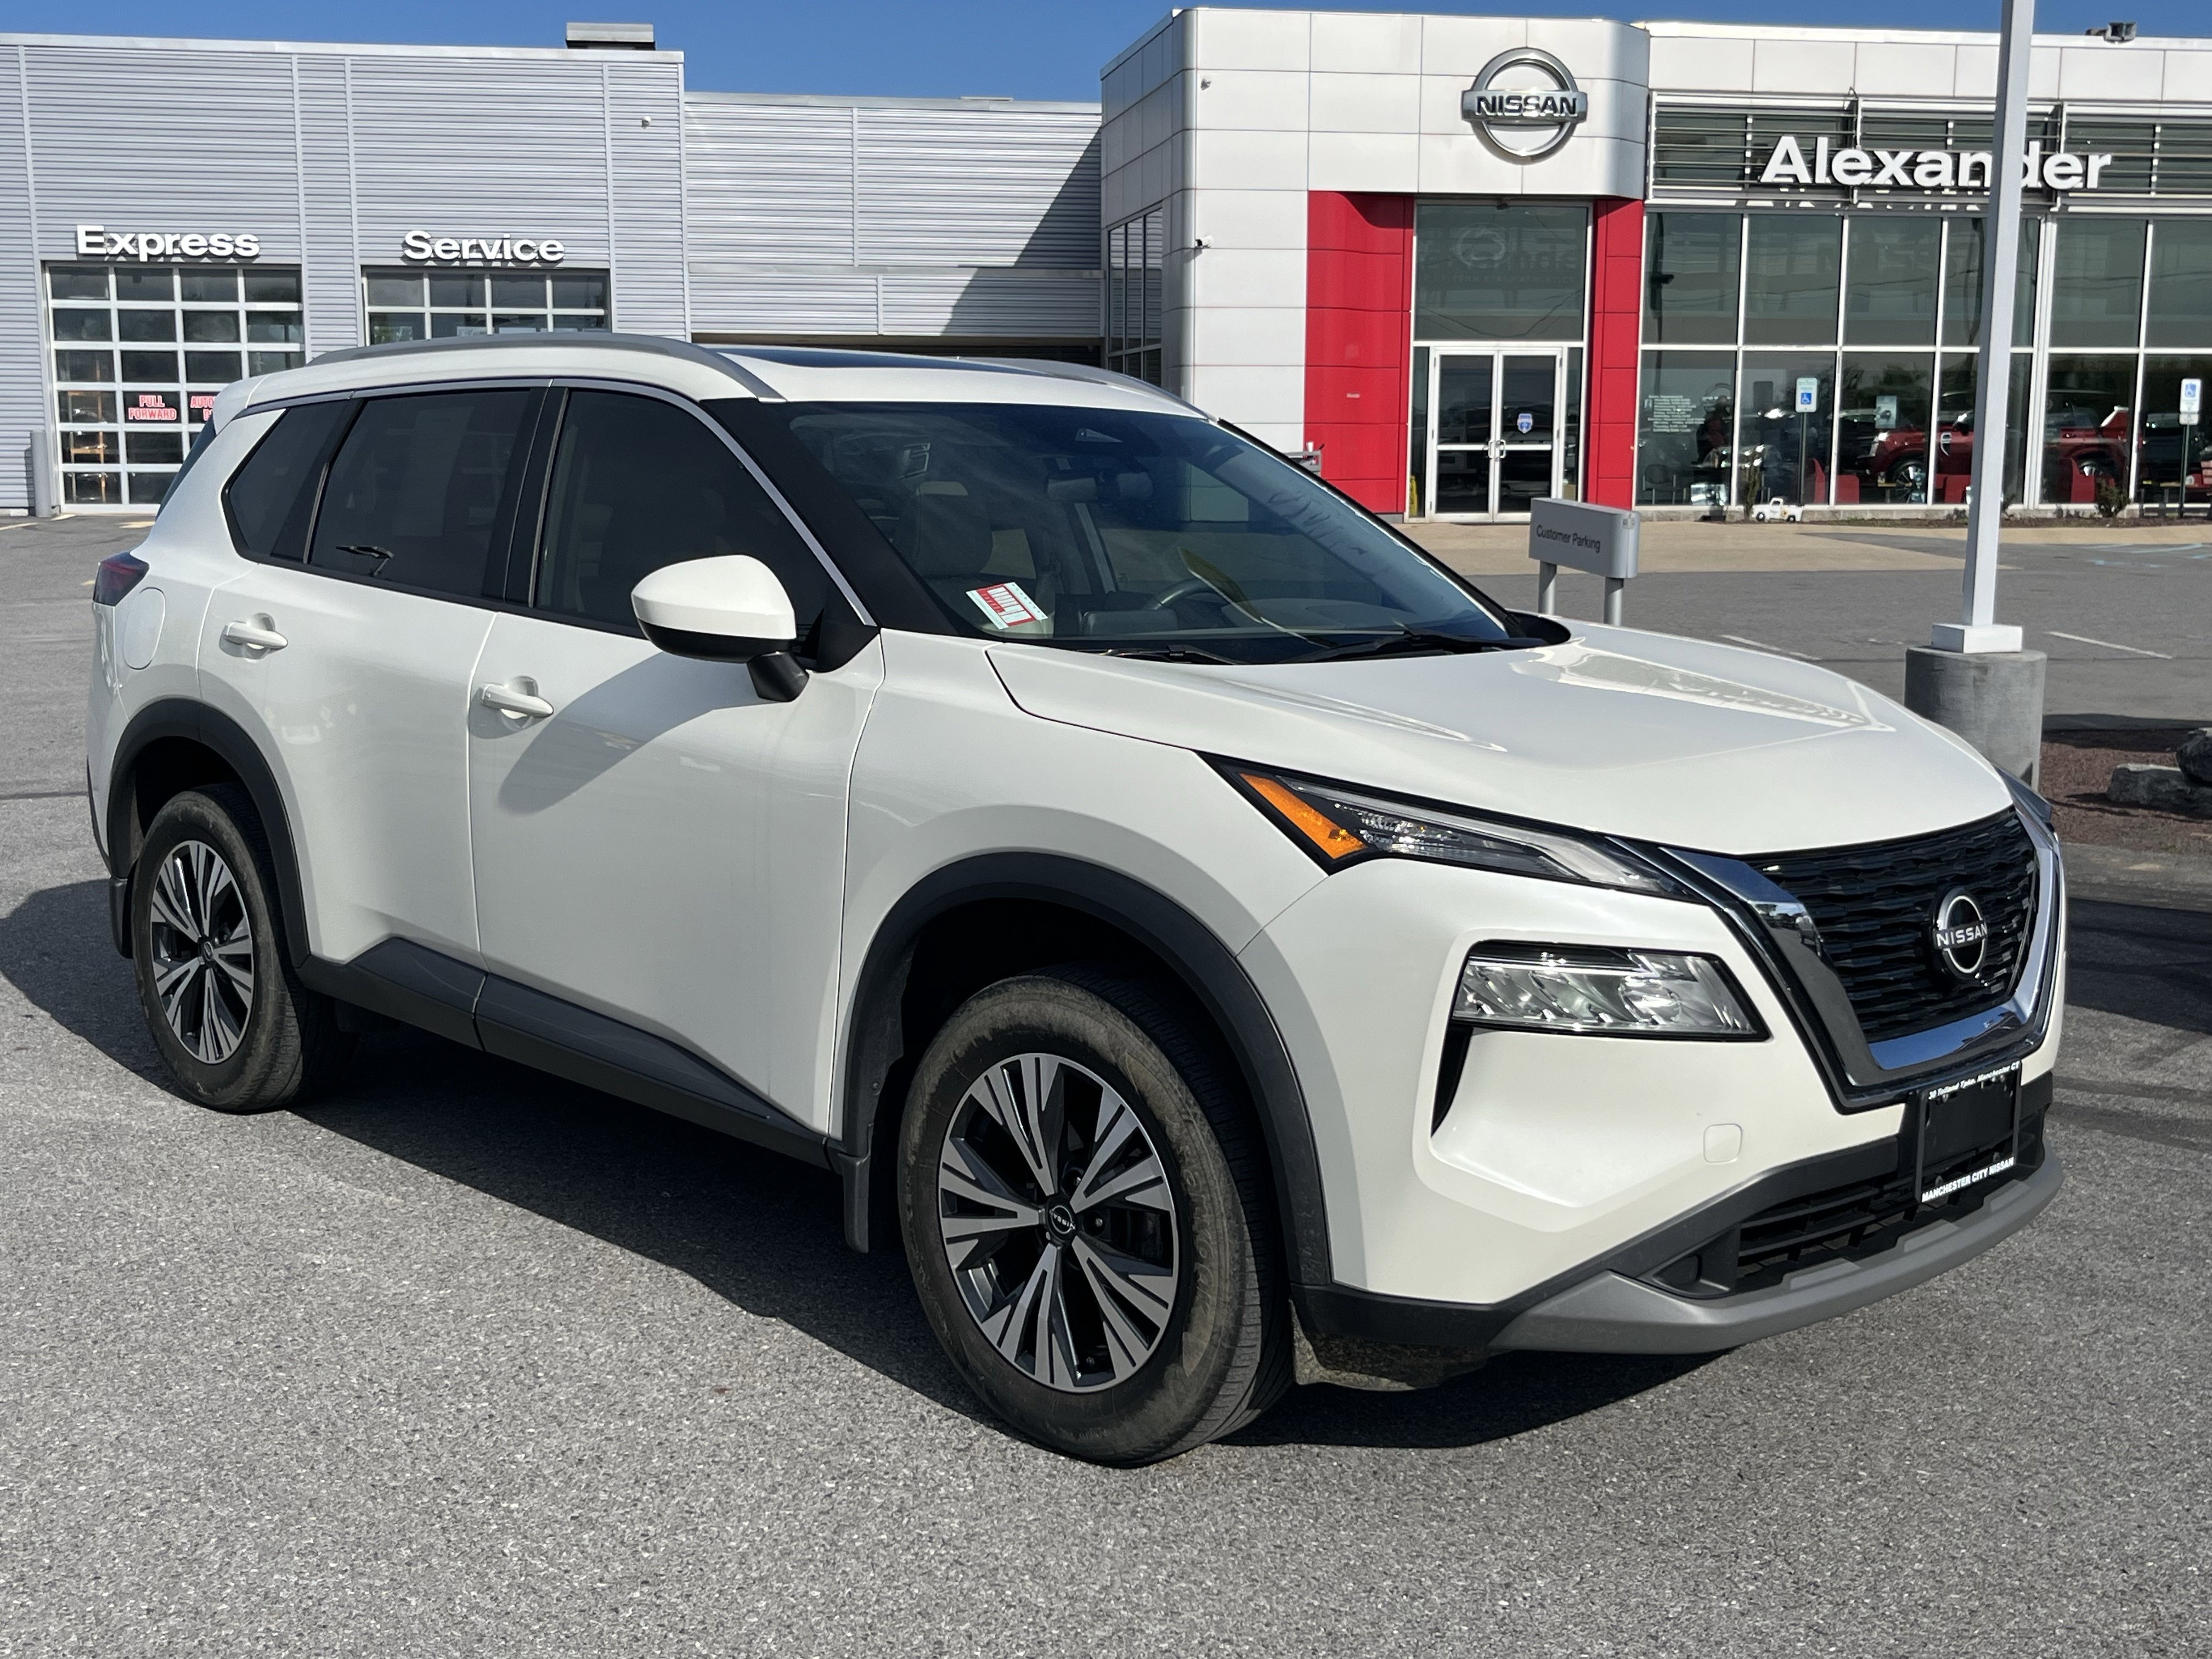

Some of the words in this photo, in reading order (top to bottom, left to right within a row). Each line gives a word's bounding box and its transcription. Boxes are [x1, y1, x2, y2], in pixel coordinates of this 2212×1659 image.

[1475, 95, 1578, 117] NISSAN
[76, 224, 260, 262] Express
[404, 230, 565, 261] Service
[139, 395, 165, 407] PULL
[190, 396, 216, 408] AUTO
[128, 407, 177, 420] FORWARD
[1537, 524, 1571, 543] Customer
[1572, 533, 1600, 554] Parking
[1936, 922, 1987, 946] NISSAN
[1922, 1175, 1971, 1203] MANCHESTER
[1972, 1167, 1988, 1182] CITY
[1989, 1156, 2014, 1175] NISSAN
